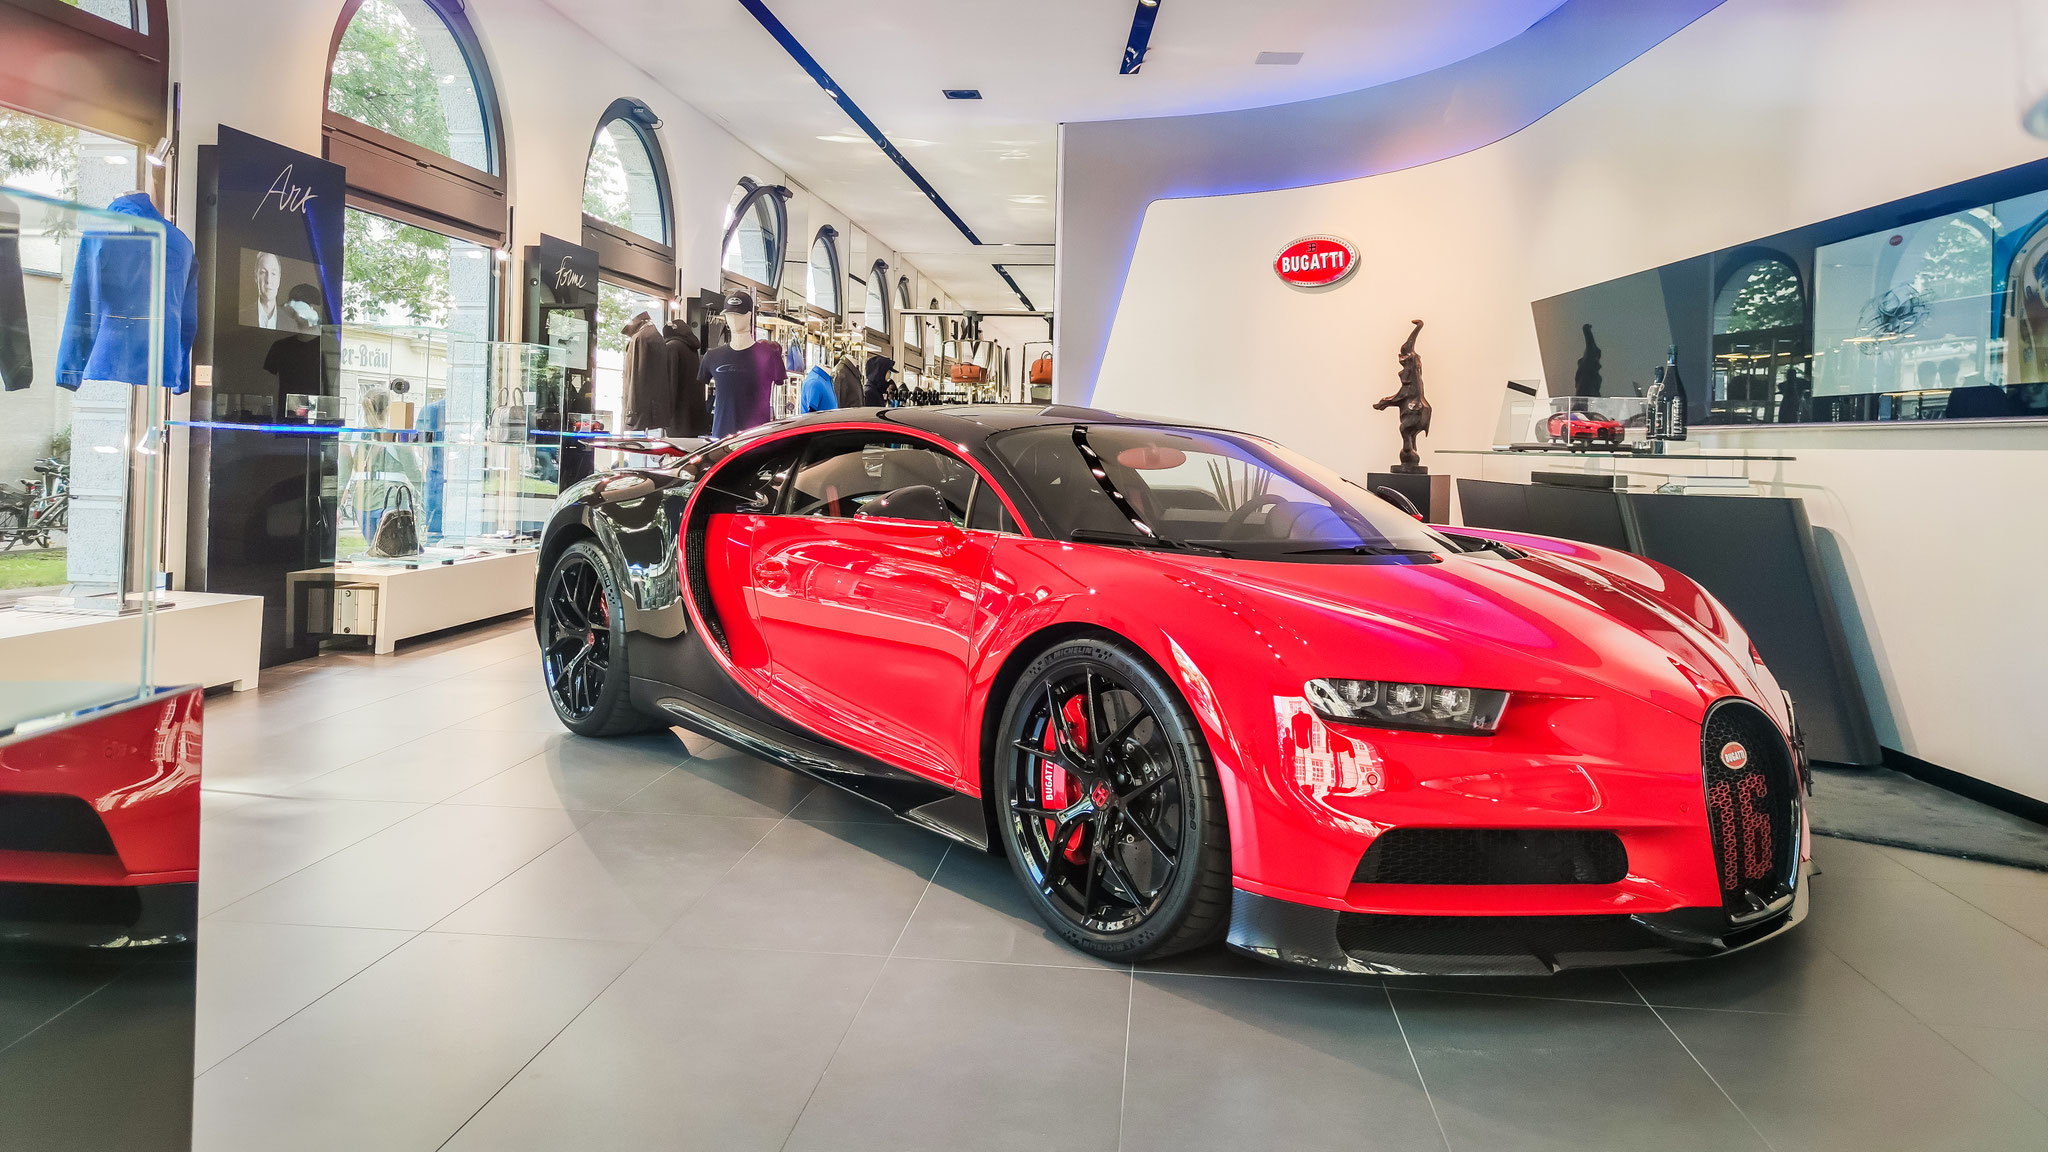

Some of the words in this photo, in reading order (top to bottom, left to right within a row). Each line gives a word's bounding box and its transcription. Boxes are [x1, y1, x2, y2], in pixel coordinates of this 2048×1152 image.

[252, 164, 318, 220] Art
[1281, 250, 1345, 274] BUGATTI
[1053, 646, 1093, 660] MICHELIN
[1725, 750, 1745, 763] BUGATTI
[1709, 773, 1772, 891] 16
